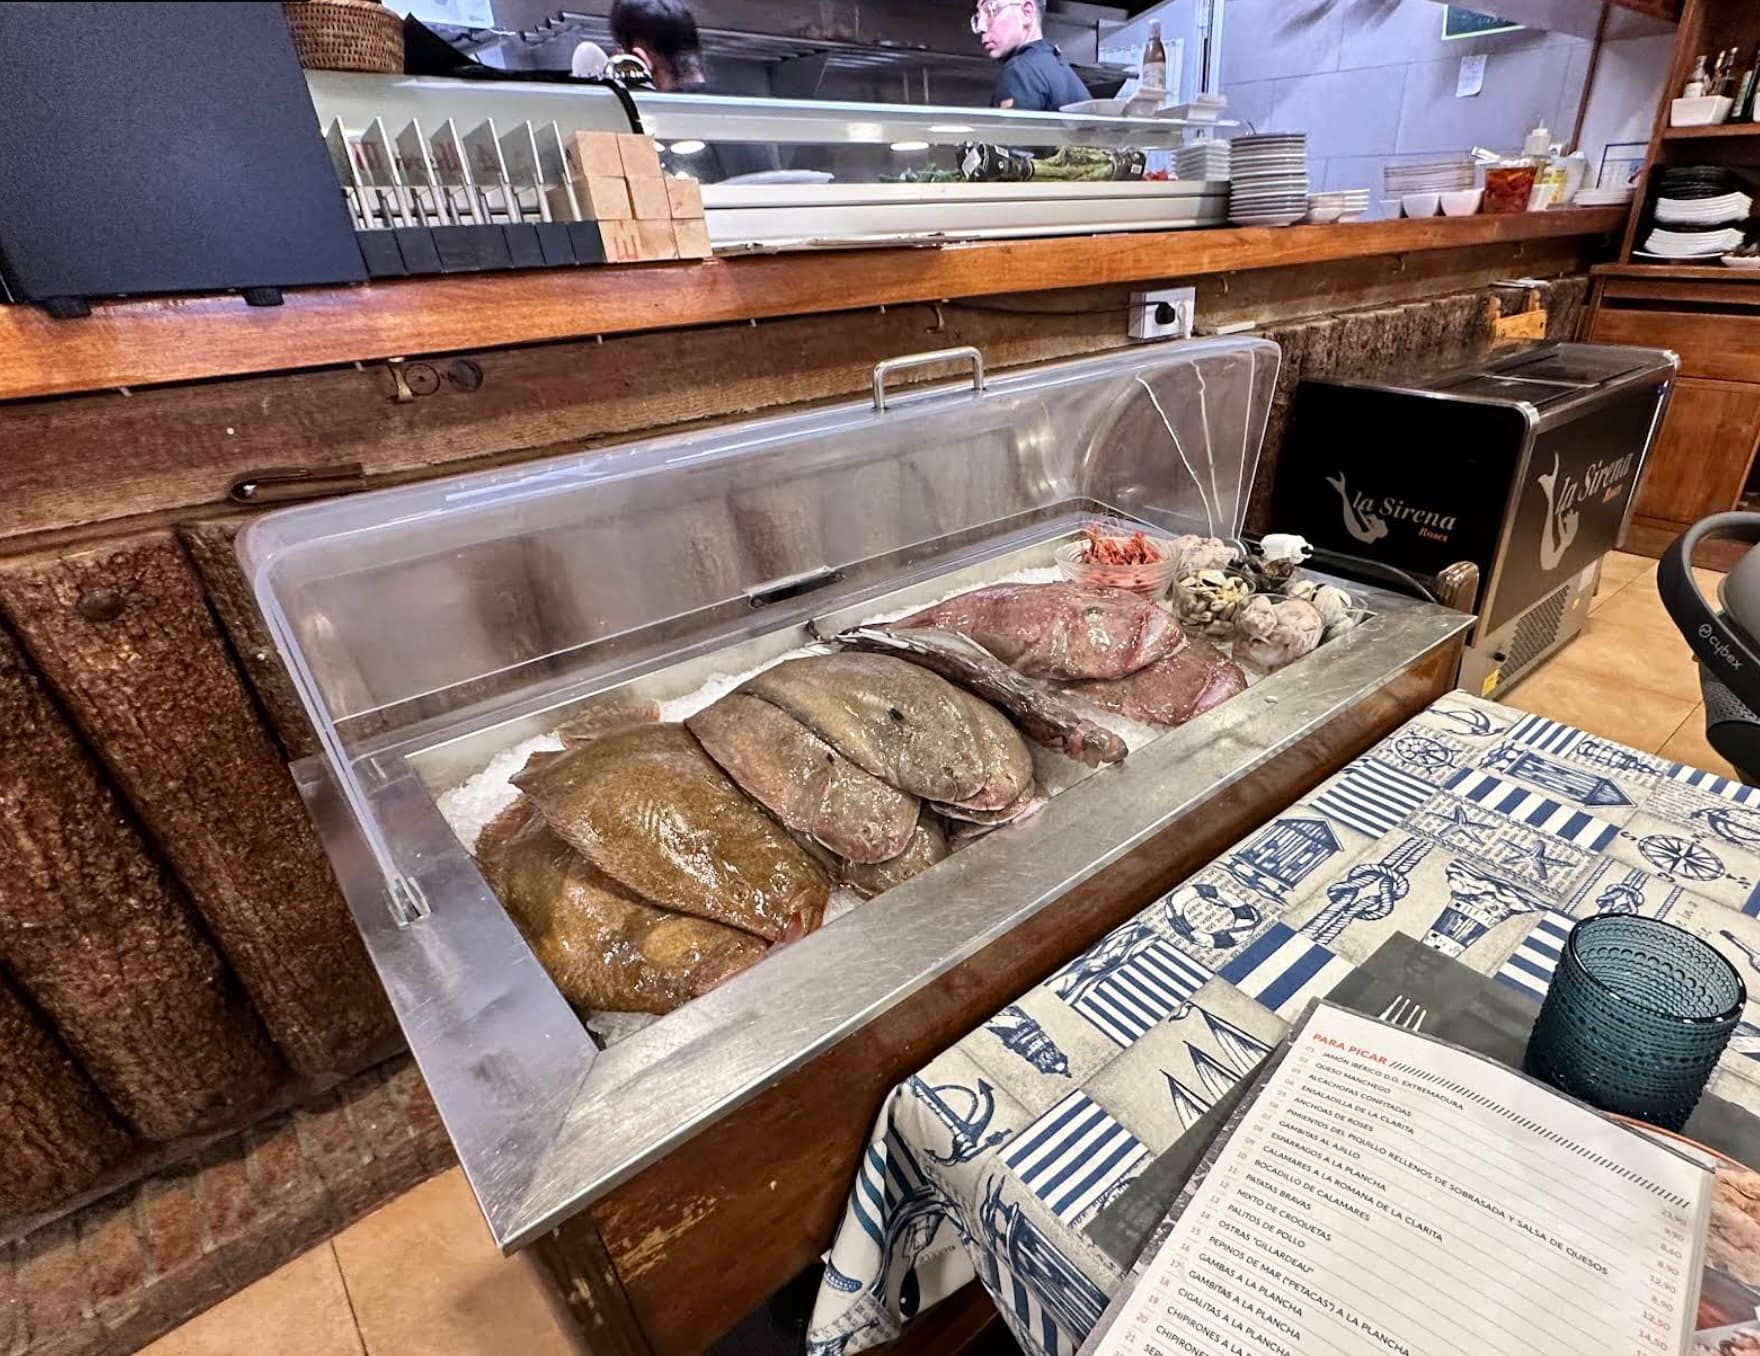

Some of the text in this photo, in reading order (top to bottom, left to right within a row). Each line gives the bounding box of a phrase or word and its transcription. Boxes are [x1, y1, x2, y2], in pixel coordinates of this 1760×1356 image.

[1554, 476, 1578, 515] la
[1577, 452, 1634, 502] Sirena
[1352, 490, 1457, 531] la Sirena
[1709, 635, 1743, 670] cybex
[1312, 1033, 1388, 1065] PARA PICAR
[1307, 1073, 1359, 1097] ALCACHOFAS
[1360, 1093, 1412, 1117] CONFITADAS
[1315, 1062, 1343, 1076] QUESO
[1344, 1073, 1391, 1094] MANCHEGO
[1401, 1080, 1464, 1111] EXTREMADURA
[1293, 1097, 1333, 1116] ANCHOAS
[1334, 1112, 1346, 1122] DE
[1347, 1116, 1374, 1132] ROSES
[1301, 1085, 1353, 1109] ENSALADILLA
[1354, 1104, 1366, 1115] DE
[1367, 1109, 1379, 1120] LA
[1379, 1115, 1415, 1135] CLARITA
[1278, 1120, 1318, 1141] GAMBITAS
[1320, 1137, 1330, 1147] AL
[1331, 1143, 1361, 1160] AJILLO
[1246, 1173, 1278, 1194] PATATAS
[1279, 1190, 1312, 1211] BRAVAS
[1254, 1159, 1301, 1186] BOCADILLO
[1302, 1182, 1315, 1193] DE
[1317, 1189, 1371, 1221] CALAMARES
[1263, 1145, 1312, 1172] CALAMARES
[1312, 1168, 1320, 1177] A
[1321, 1172, 1333, 1183] LA
[1334, 1178, 1375, 1205] ROMANA
[1375, 1200, 1390, 1213] DE
[1390, 1208, 1403, 1220] LA
[1404, 1216, 1443, 1243] CLARITA
[1286, 1109, 1329, 1130] PIMIENTOS
[1330, 1126, 1345, 1137] DEL
[1347, 1133, 1387, 1155] PIQUILLO
[1387, 1151, 1433, 1180] RELLENOS
[1434, 1176, 1448, 1187] DE
[1449, 1183, 1505, 1218] SOBRASADA
[1508, 1214, 1515, 1223] Y
[1516, 1219, 1547, 1242] SALSA
[1549, 1237, 1564, 1251] DE
[1565, 1247, 1608, 1275] QUESOS
[1322, 1155, 1330, 1164] A
[1331, 1159, 1343, 1170] LA
[1344, 1165, 1387, 1192] PLANCHA
[1218, 1219, 1251, 1241] OSTRAS
[1227, 1203, 1261, 1226] PALITOS
[1262, 1222, 1274, 1233] DE
[1275, 1228, 1306, 1248] POLLO
[1236, 1188, 1264, 1207] MIXTO
[1265, 1203, 1278, 1214] DE
[1278, 1210, 1332, 1242] CROQUETAS
[1188, 1270, 1232, 1299] GAMBITAS
[1233, 1296, 1241, 1305] A
[1242, 1300, 1254, 1313] LA
[1255, 1308, 1301, 1341] PLANCHA
[1199, 1252, 1236, 1277] GAMBAS
[1236, 1274, 1244, 1283] A
[1245, 1278, 1257, 1290] LA
[1258, 1285, 1303, 1317] PLANCHA
[1208, 1236, 1245, 1260] PEPINOS
[1246, 1256, 1259, 1268] DE
[1260, 1263, 1282, 1280] MAR
[1335, 1308, 1344, 1318] A
[1346, 1313, 1359, 1327] LA
[1360, 1322, 1410, 1356] PLANCHA
[1124, 1332, 1136, 1344] 21
[1156, 1324, 1210, 1356] CHIPIRON
[1167, 1306, 1221, 1343] CHIPIRONES
[1220, 1339, 1229, 1348] A
[1230, 1343, 1243, 1356] LA
[1178, 1287, 1221, 1318] CIGALITAS
[1222, 1314, 1230, 1324] A
[1231, 1319, 1243, 1331] LA
[1245, 1326, 1291, 1356] PLANCHA
